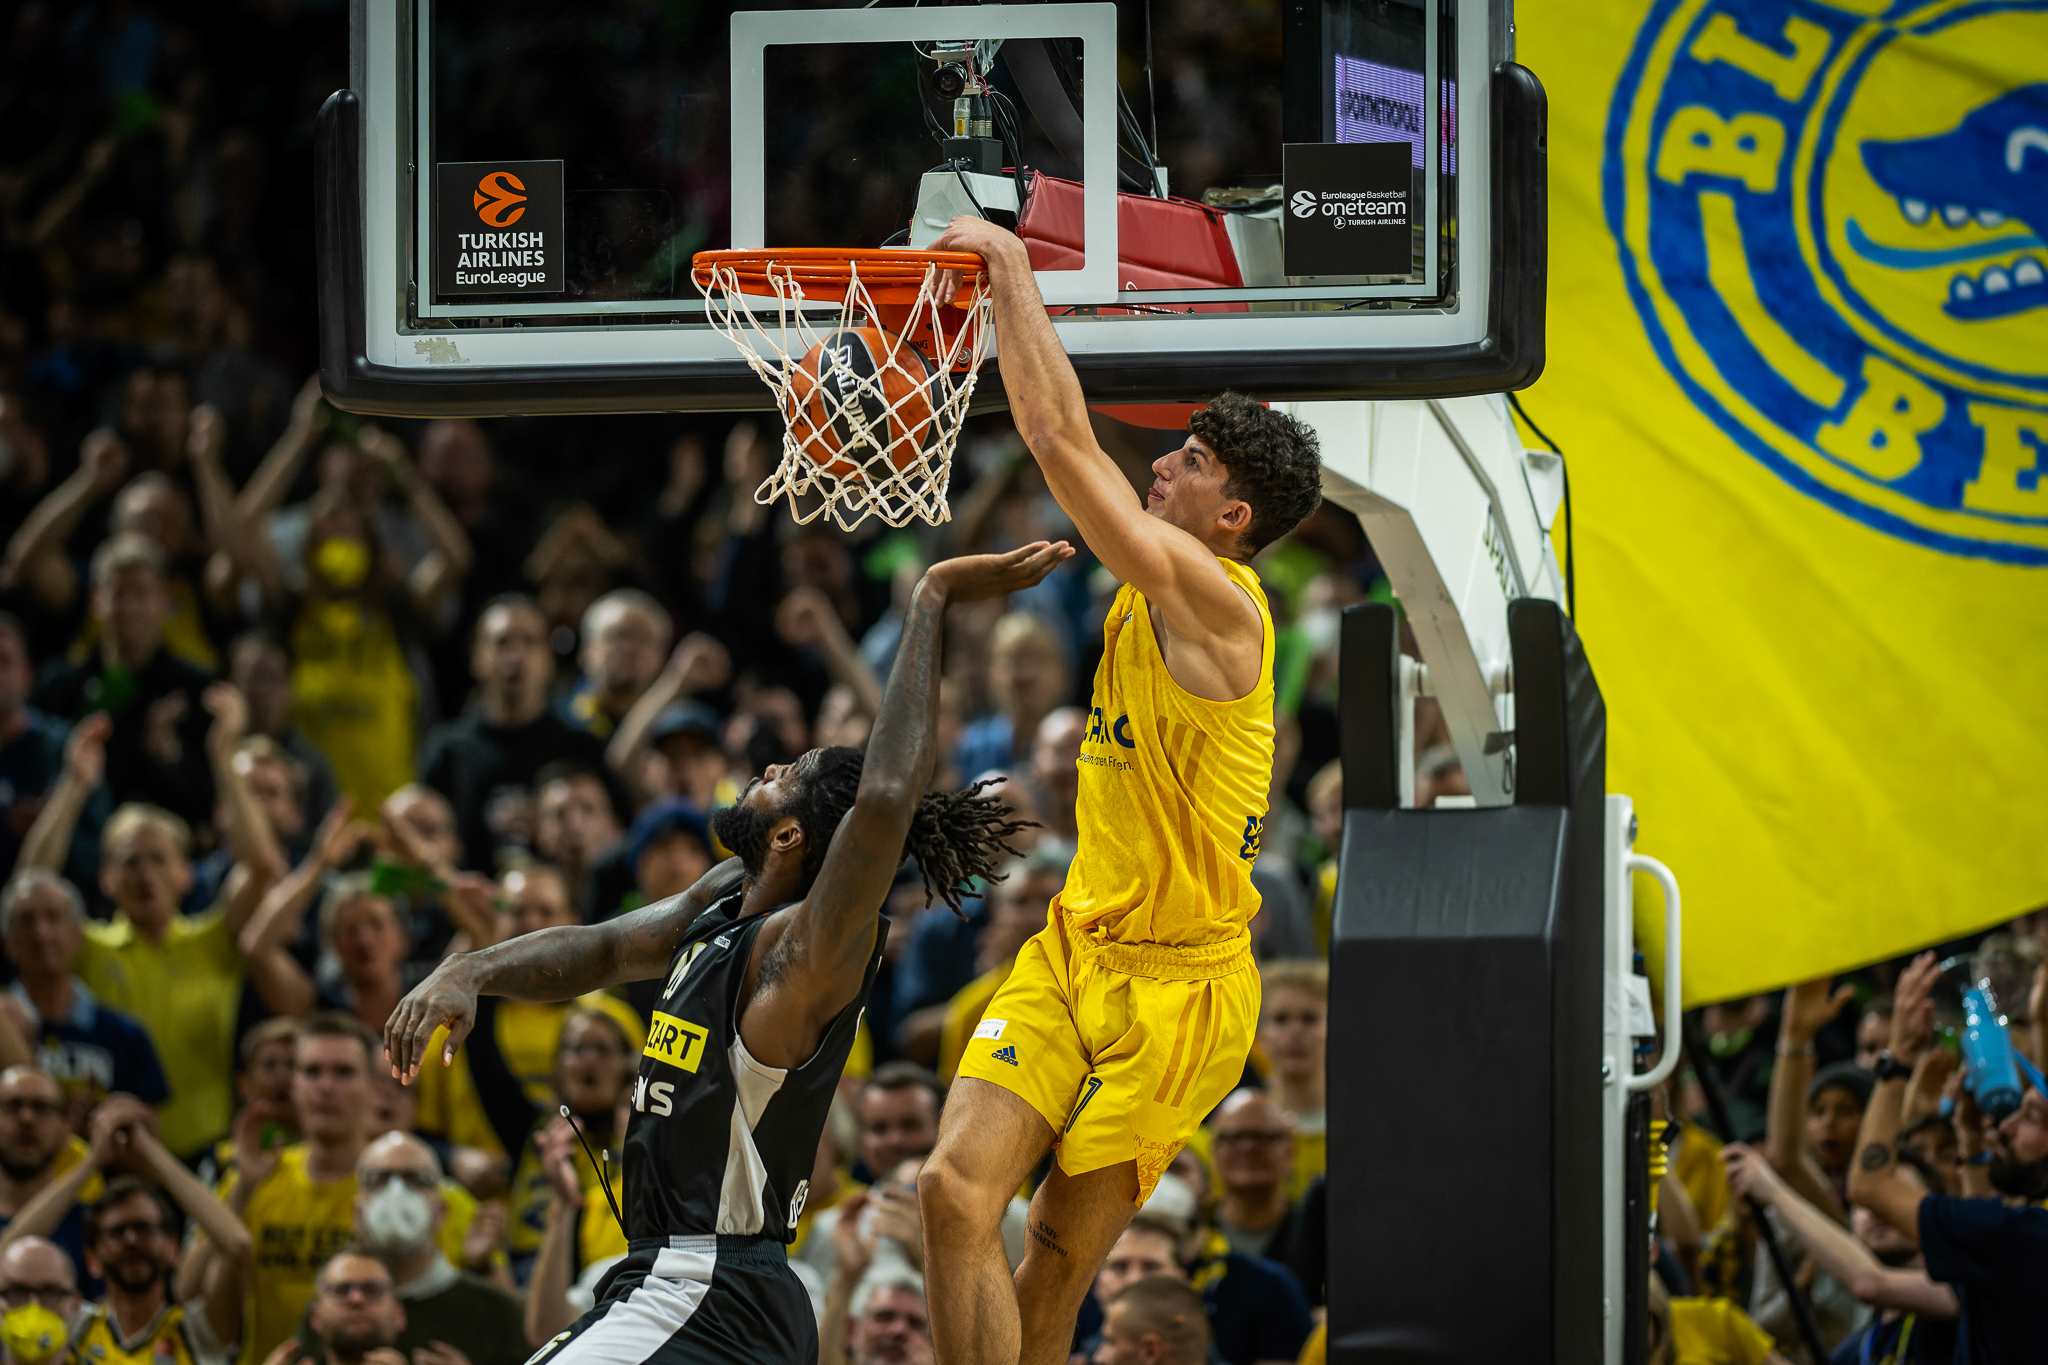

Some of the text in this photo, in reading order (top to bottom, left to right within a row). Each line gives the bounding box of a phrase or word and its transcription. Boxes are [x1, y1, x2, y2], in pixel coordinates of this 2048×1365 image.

[1321, 190, 1407, 201] Euroleague Basketball
[1321, 199, 1406, 216] oneteam
[458, 231, 543, 249] TURKISH
[457, 250, 545, 268] AIRLINES
[455, 270, 546, 287] EuroLeague
[991, 1052, 1019, 1067] adidas
